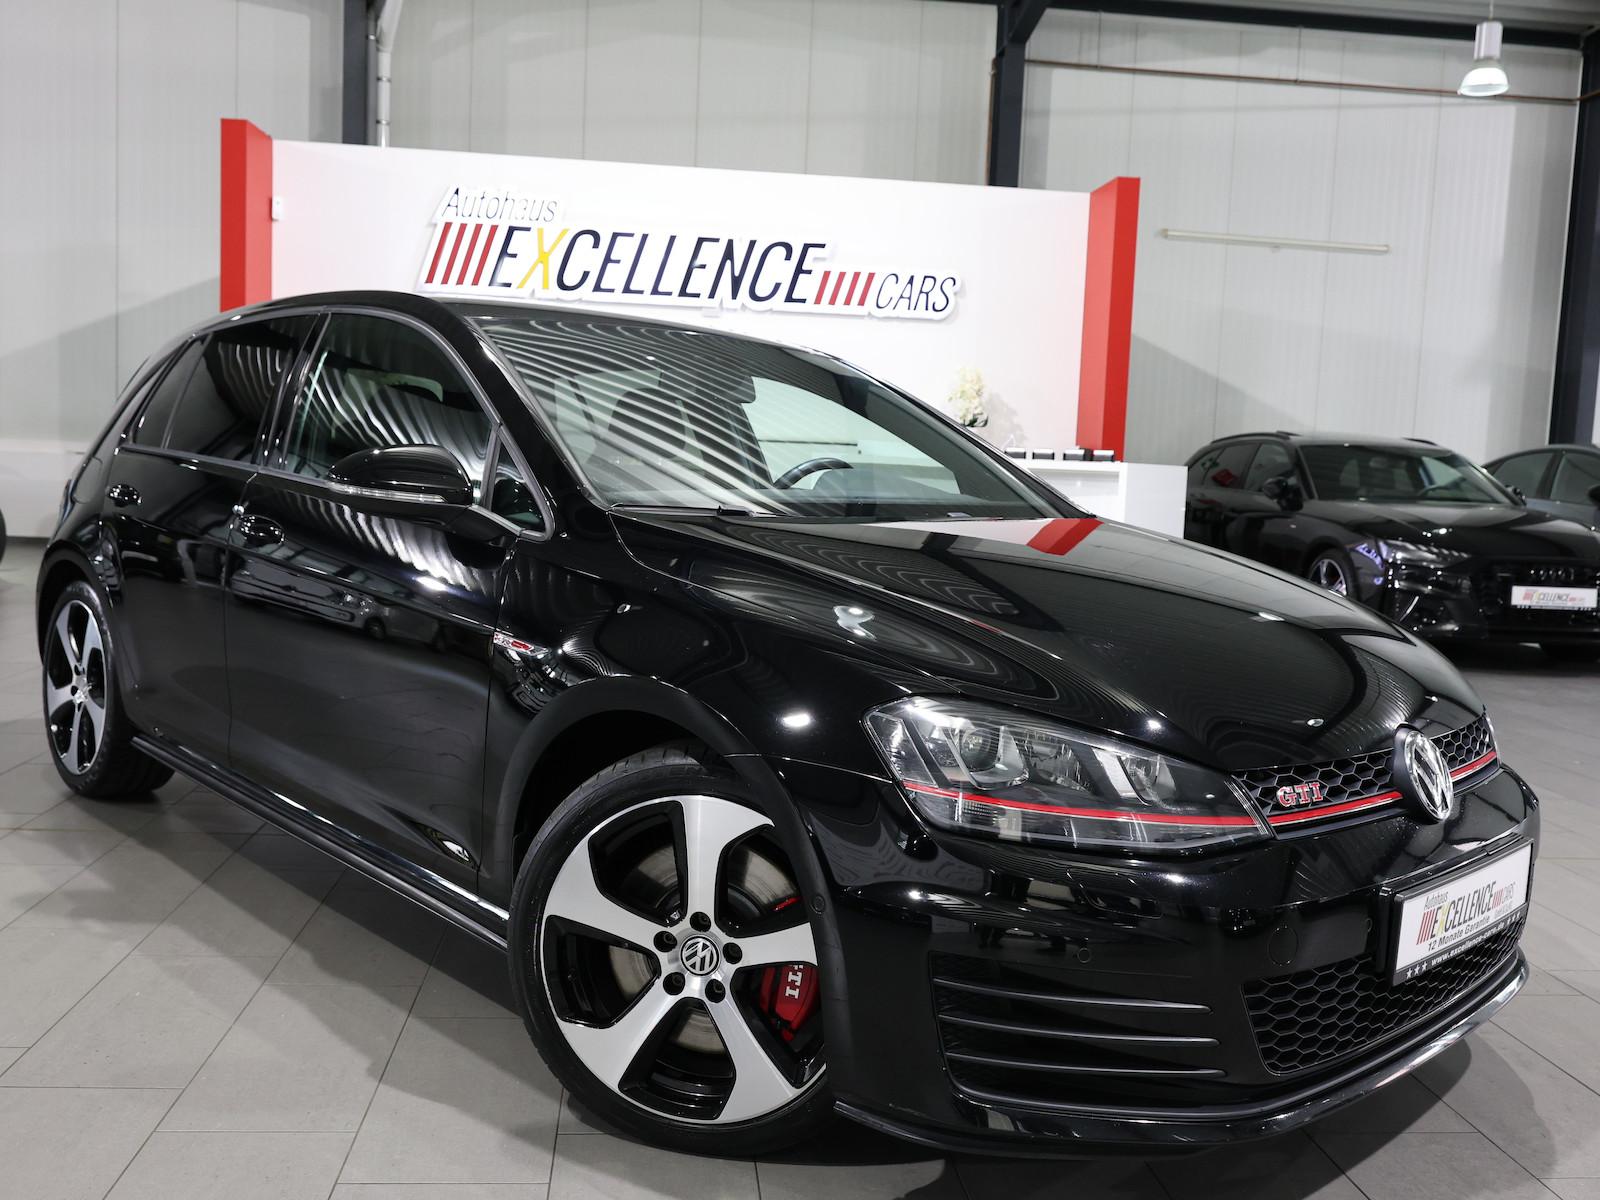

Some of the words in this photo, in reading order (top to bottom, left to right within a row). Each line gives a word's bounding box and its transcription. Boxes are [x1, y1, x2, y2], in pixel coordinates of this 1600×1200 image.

[442, 187, 557, 222] Autohaus
[488, 225, 826, 304] EXCELLENCE
[875, 273, 956, 312] CARS
[1276, 782, 1324, 808] GTI
[1424, 891, 1449, 910] Autohaus
[1429, 881, 1497, 940] EXCELLENCE
[1428, 940, 1437, 951] 12
[1438, 929, 1464, 948] Monate
[1465, 915, 1490, 935] Garantie
[785, 965, 804, 999] TI
